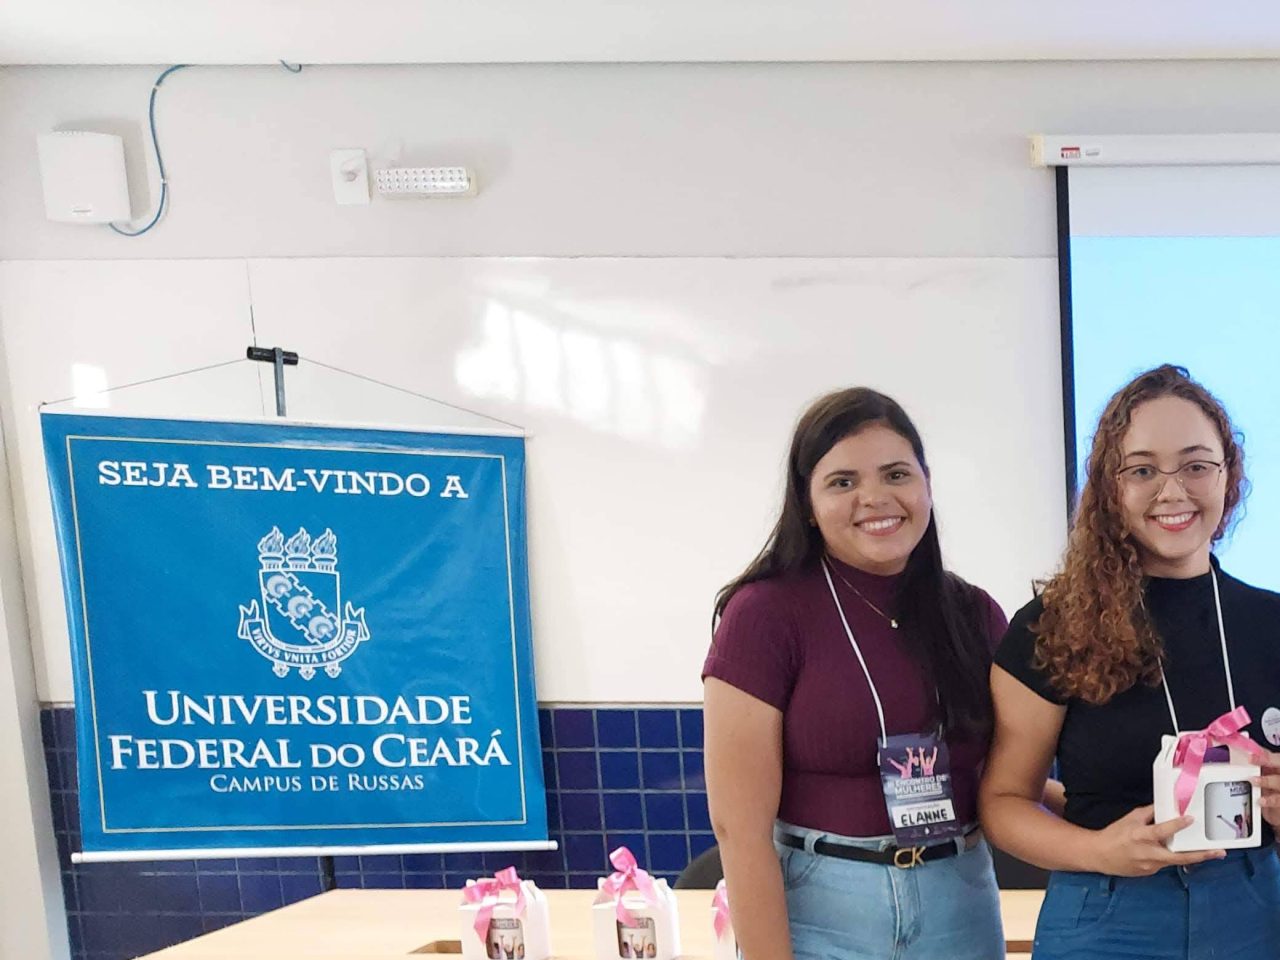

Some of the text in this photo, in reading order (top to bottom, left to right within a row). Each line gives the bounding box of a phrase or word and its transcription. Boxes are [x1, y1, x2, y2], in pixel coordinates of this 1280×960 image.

[98, 460, 469, 498] SEJA BEM-VINDO A
[142, 690, 472, 726] UNIVERSIDADE
[108, 729, 512, 770] FEDERAL DO CEARÁ
[210, 773, 424, 792] CAMPUS DE RUSSAS
[901, 808, 948, 826] ELANNE
